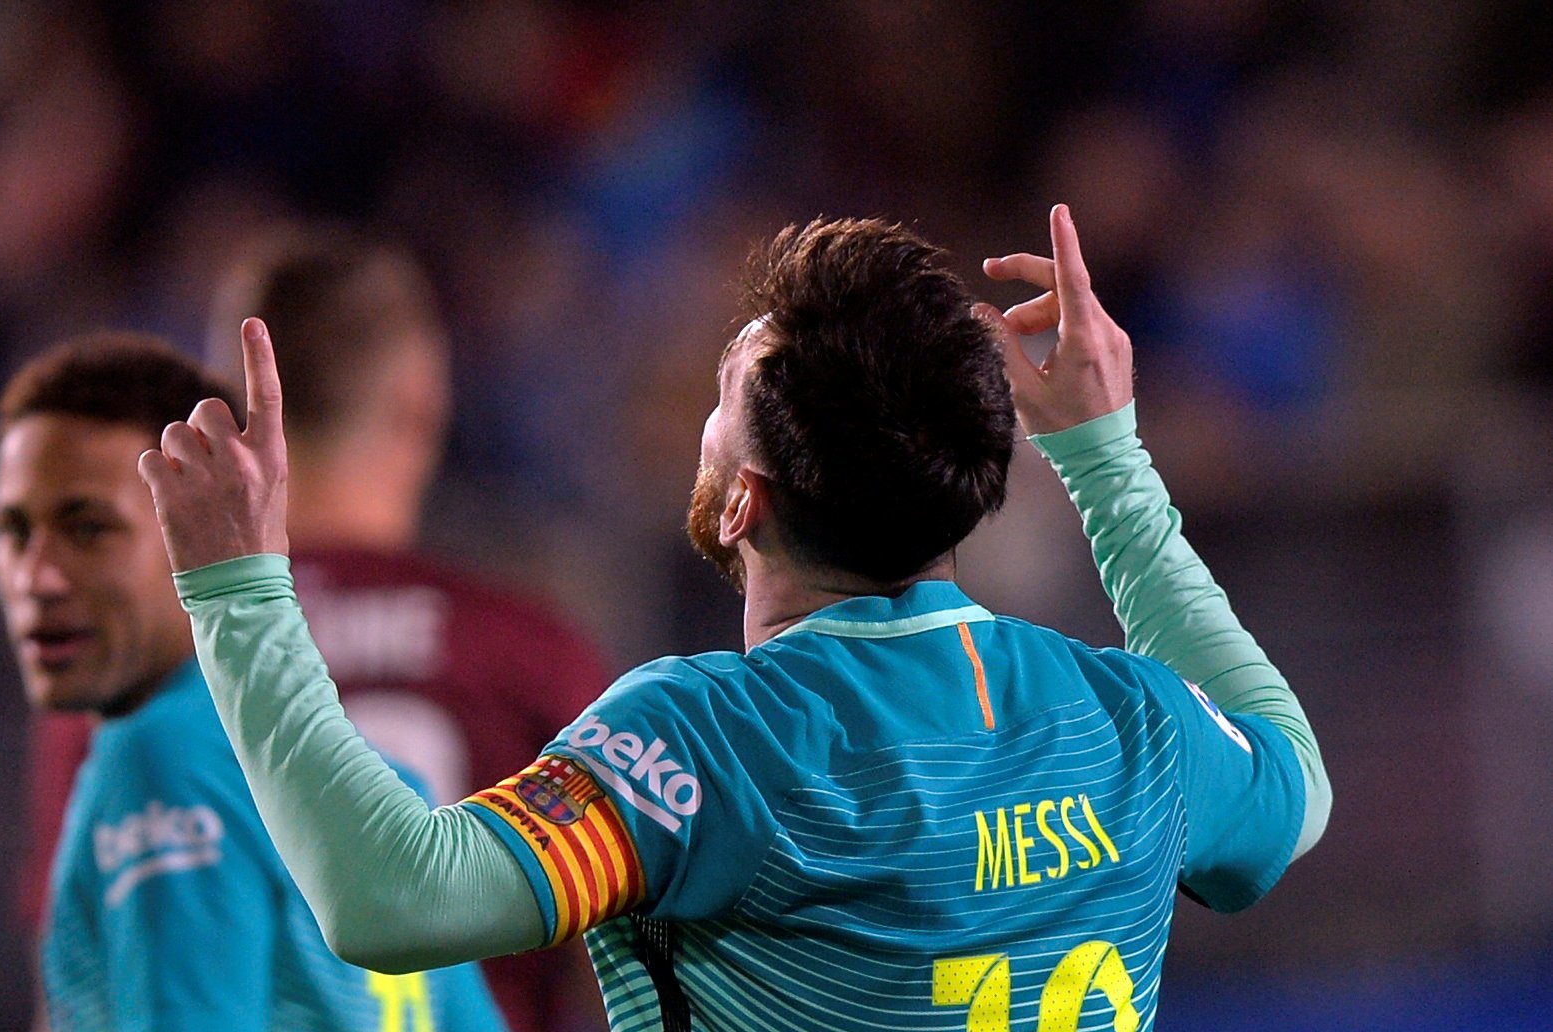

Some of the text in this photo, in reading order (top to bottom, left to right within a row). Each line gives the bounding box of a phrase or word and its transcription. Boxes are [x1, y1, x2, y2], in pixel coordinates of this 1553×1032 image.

[568, 715, 702, 816] beko
[92, 799, 226, 873] beko
[974, 793, 1120, 891] MESSI
